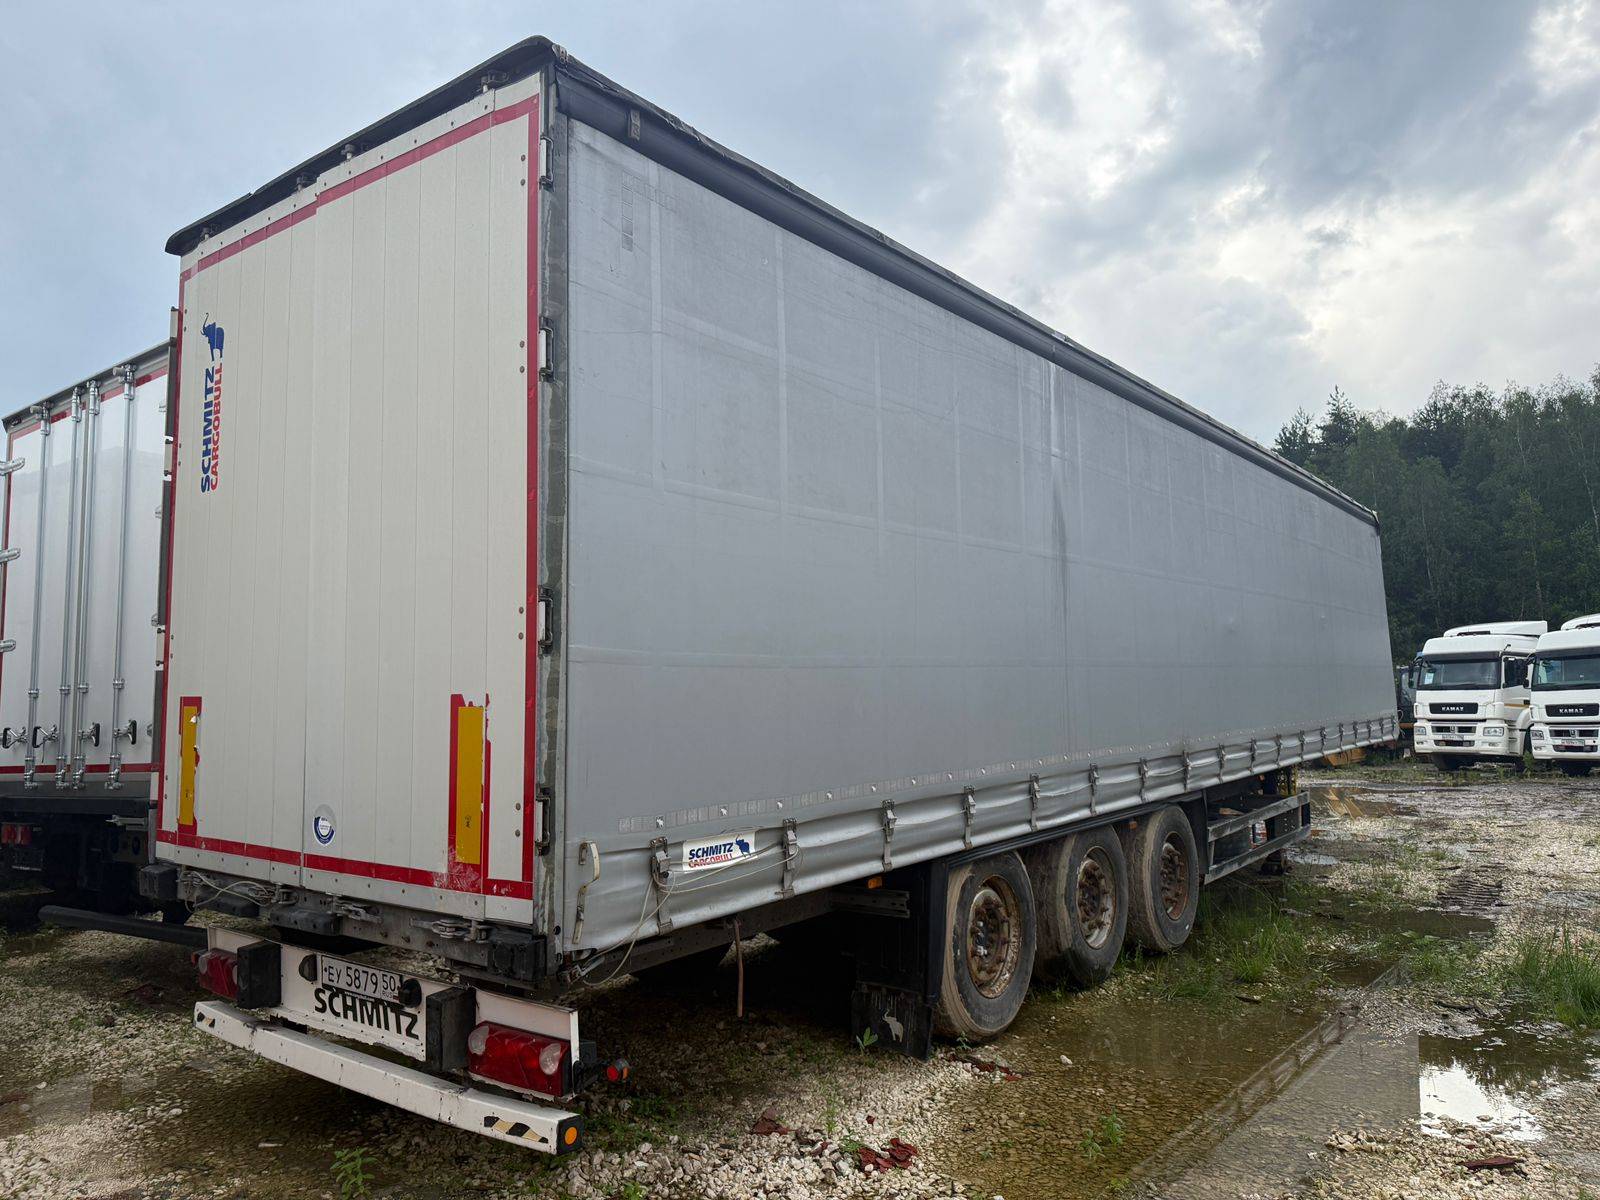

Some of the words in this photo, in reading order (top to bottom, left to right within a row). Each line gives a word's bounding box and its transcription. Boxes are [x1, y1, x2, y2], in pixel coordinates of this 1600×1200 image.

[201, 366, 215, 493] SCHMITZ
[210, 363, 223, 491] CARGOBULL
[688, 842, 733, 860] SCHMITZ
[346, 966, 379, 994] 5879
[382, 973, 396, 992] 50
[314, 987, 419, 1040] SCHMITZ
